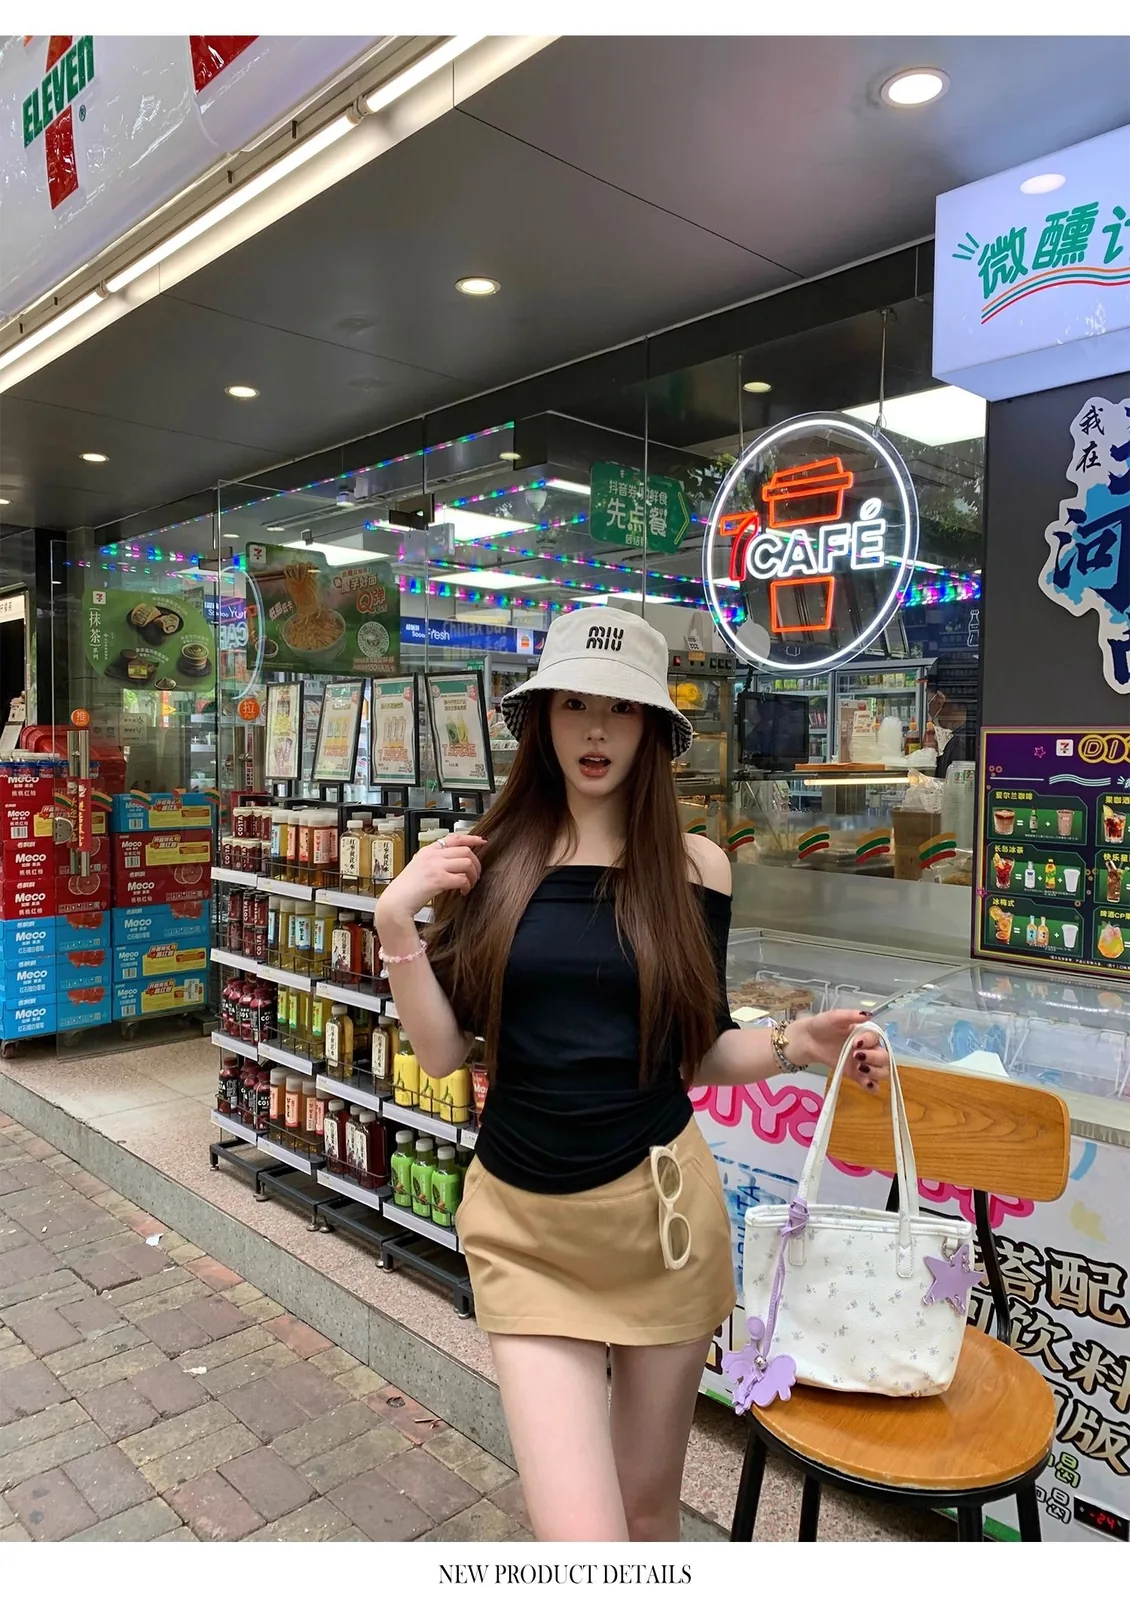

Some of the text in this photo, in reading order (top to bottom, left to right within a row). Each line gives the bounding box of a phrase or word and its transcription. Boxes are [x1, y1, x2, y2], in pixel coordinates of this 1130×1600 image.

[1075, 405, 1105, 473] 我在
[606, 497, 667, 537] 先点餐
[243, 701, 256, 713] 拉
[76, 711, 86, 721] 推
[1084, 738, 1130, 760] DI
[995, 791, 1033, 800] 爱尔兰咖啡
[994, 845, 1024, 854] 长岛冰茶
[15, 853, 46, 863] Meco
[1103, 853, 1130, 862] 快乐星
[127, 881, 155, 891] Meco
[15, 893, 46, 903] Meco
[124, 919, 152, 928] Meco
[15, 931, 46, 942] Meco
[118, 951, 139, 959] Meco
[17, 970, 47, 981] Meco
[117, 988, 138, 996] Meco
[15, 1008, 46, 1020] Meco
[1053, 1394, 1130, 1474] 版
